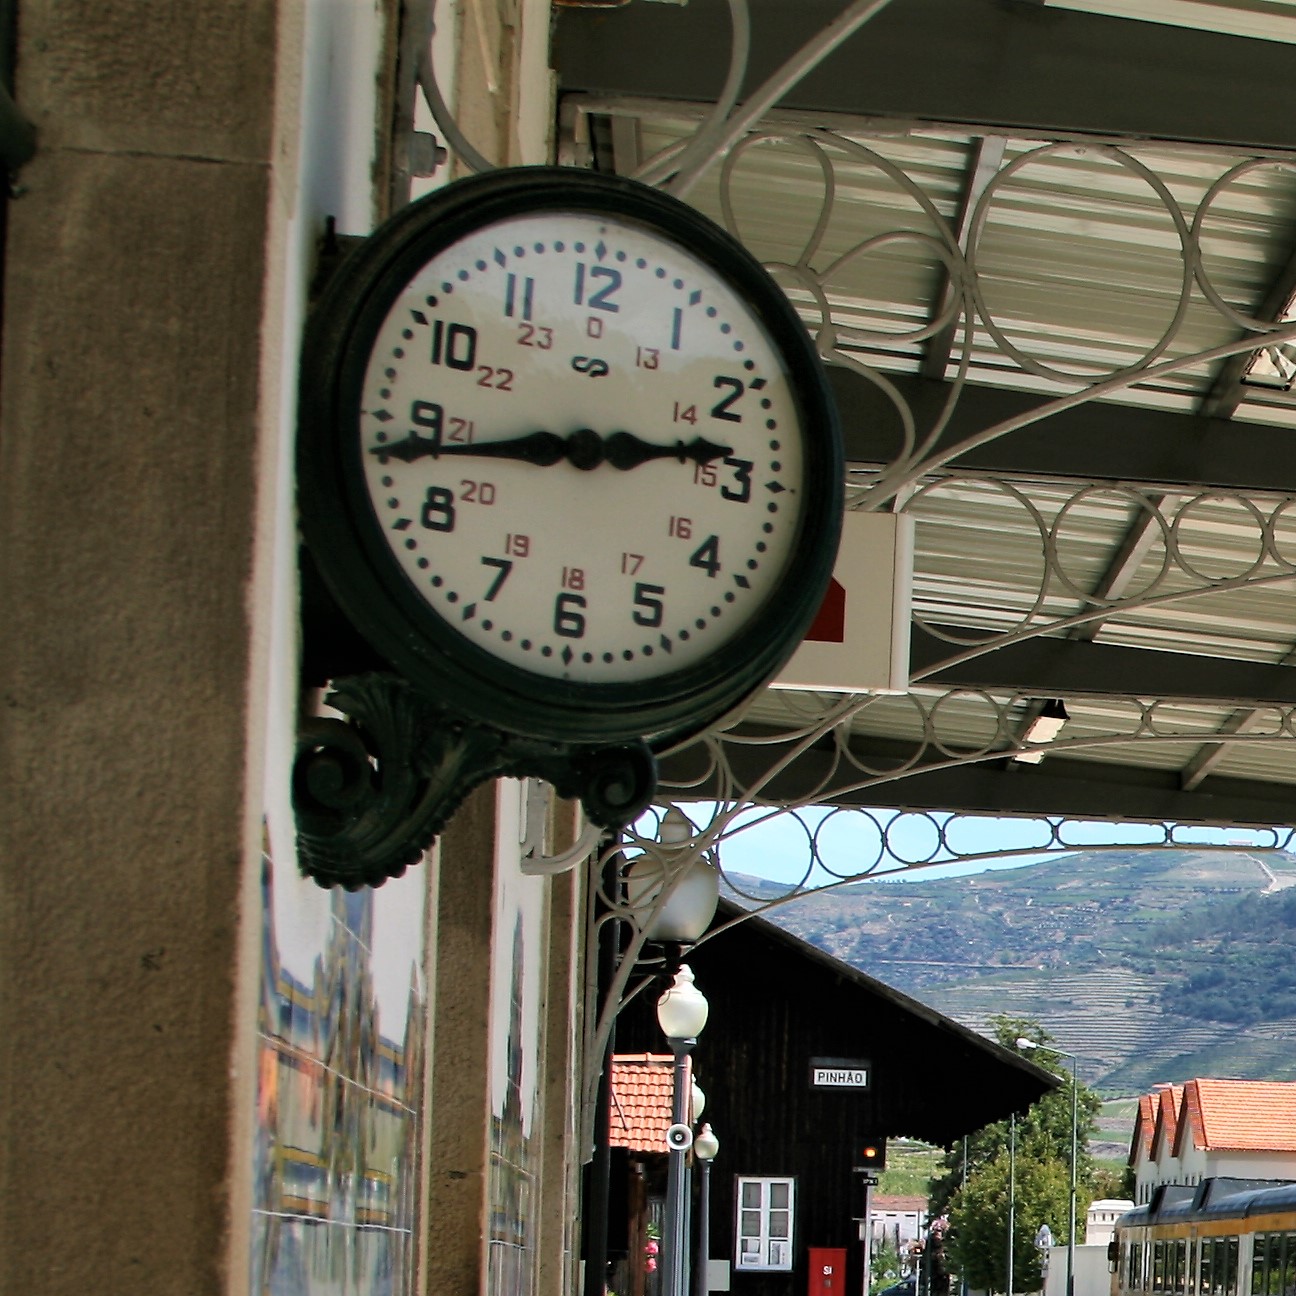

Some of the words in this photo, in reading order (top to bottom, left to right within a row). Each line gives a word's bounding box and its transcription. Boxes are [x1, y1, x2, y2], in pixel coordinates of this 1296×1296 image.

[504, 273, 534, 322] 11
[574, 262, 623, 313] 12
[431, 319, 478, 372] 10
[517, 323, 554, 350] 23
[670, 307, 683, 350] 1
[476, 365, 514, 391] 22
[635, 346, 660, 370] 13
[673, 401, 697, 425] 14
[711, 375, 745, 423] 2
[411, 400, 444, 451] 9
[447, 416, 474, 446] 21
[459, 479, 496, 506] 20
[692, 463, 718, 488] 15
[720, 456, 754, 504] 3
[420, 485, 456, 533] 8
[668, 515, 692, 540] 16
[504, 533, 531, 558] 19
[620, 552, 645, 576] 17
[689, 534, 721, 579] 4
[480, 556, 513, 602] 7
[561, 567, 585, 591] 18
[554, 592, 587, 639] 6
[632, 582, 665, 628] 5
